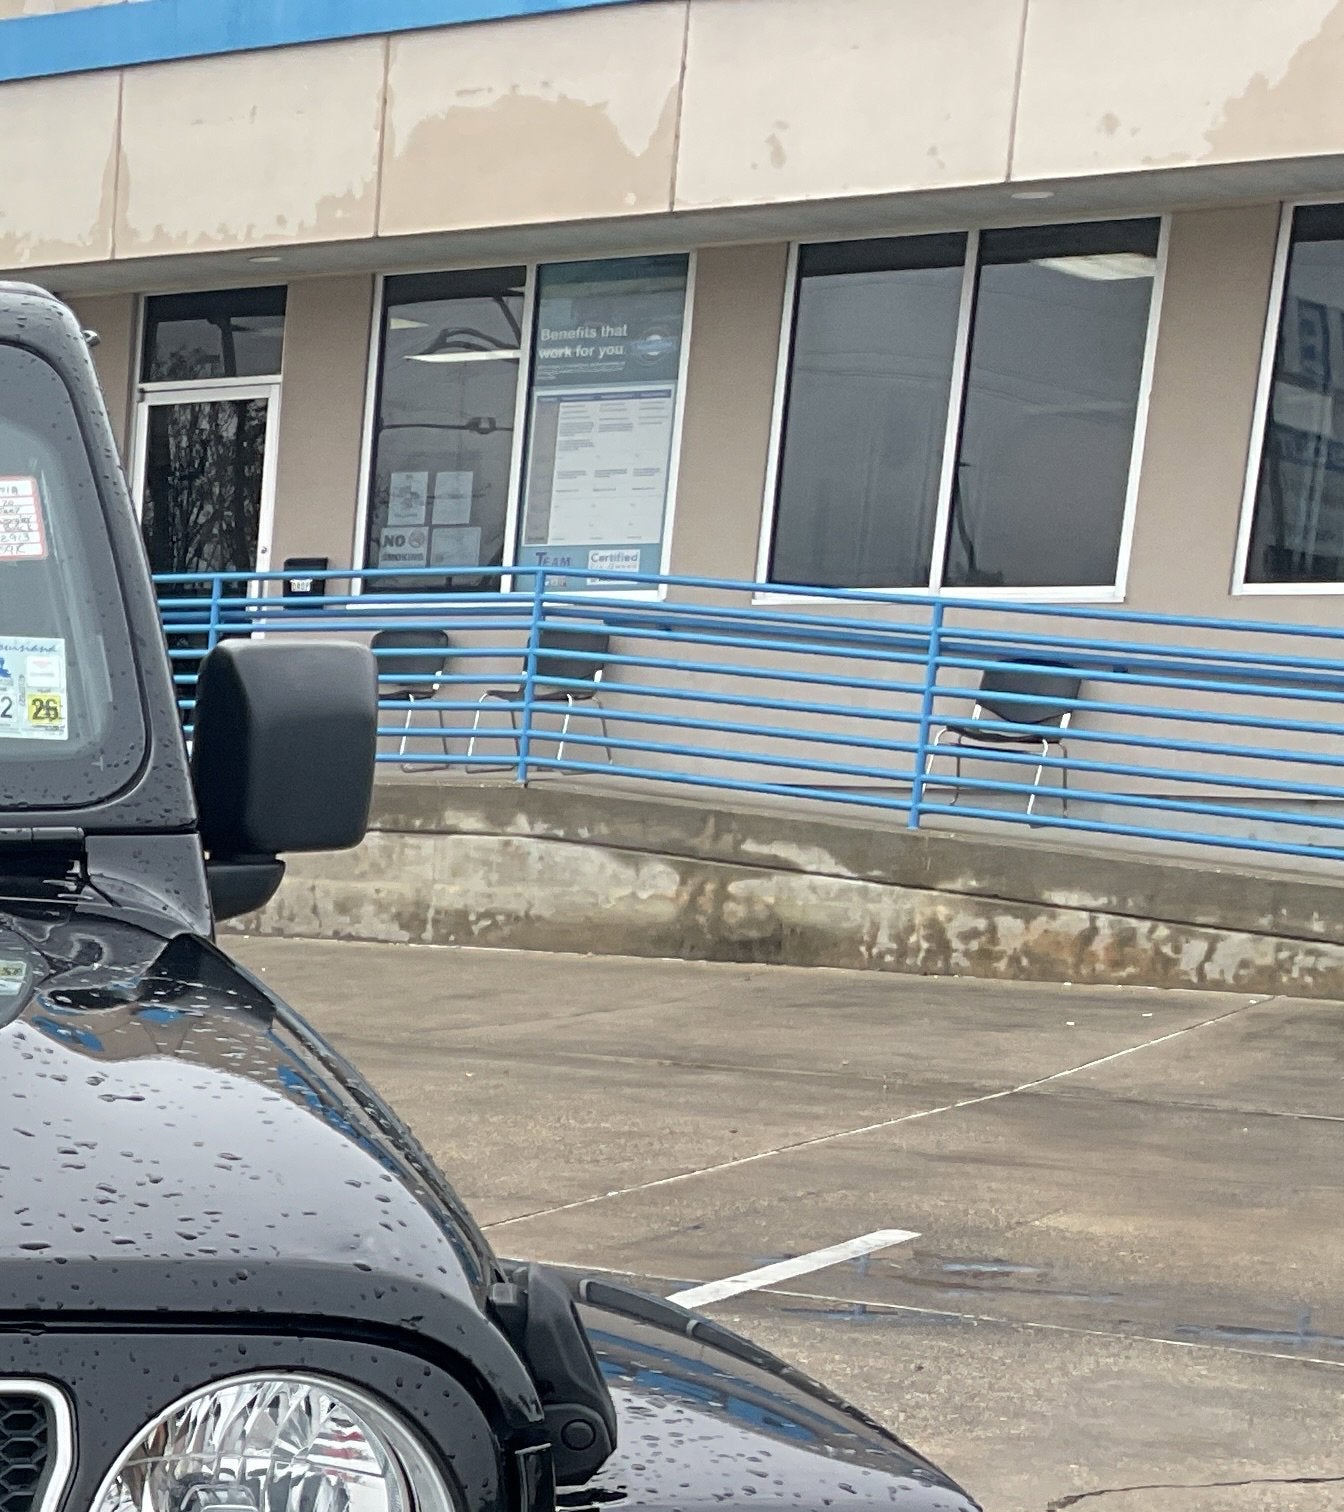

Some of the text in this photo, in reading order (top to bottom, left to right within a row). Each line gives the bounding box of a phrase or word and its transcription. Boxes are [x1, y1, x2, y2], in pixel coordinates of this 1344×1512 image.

[541, 324, 628, 341] Benefits that
[539, 347, 572, 359] work
[576, 345, 594, 356] for
[383, 534, 406, 547] NO
[591, 551, 638, 563] Certified
[32, 698, 60, 721] 26
